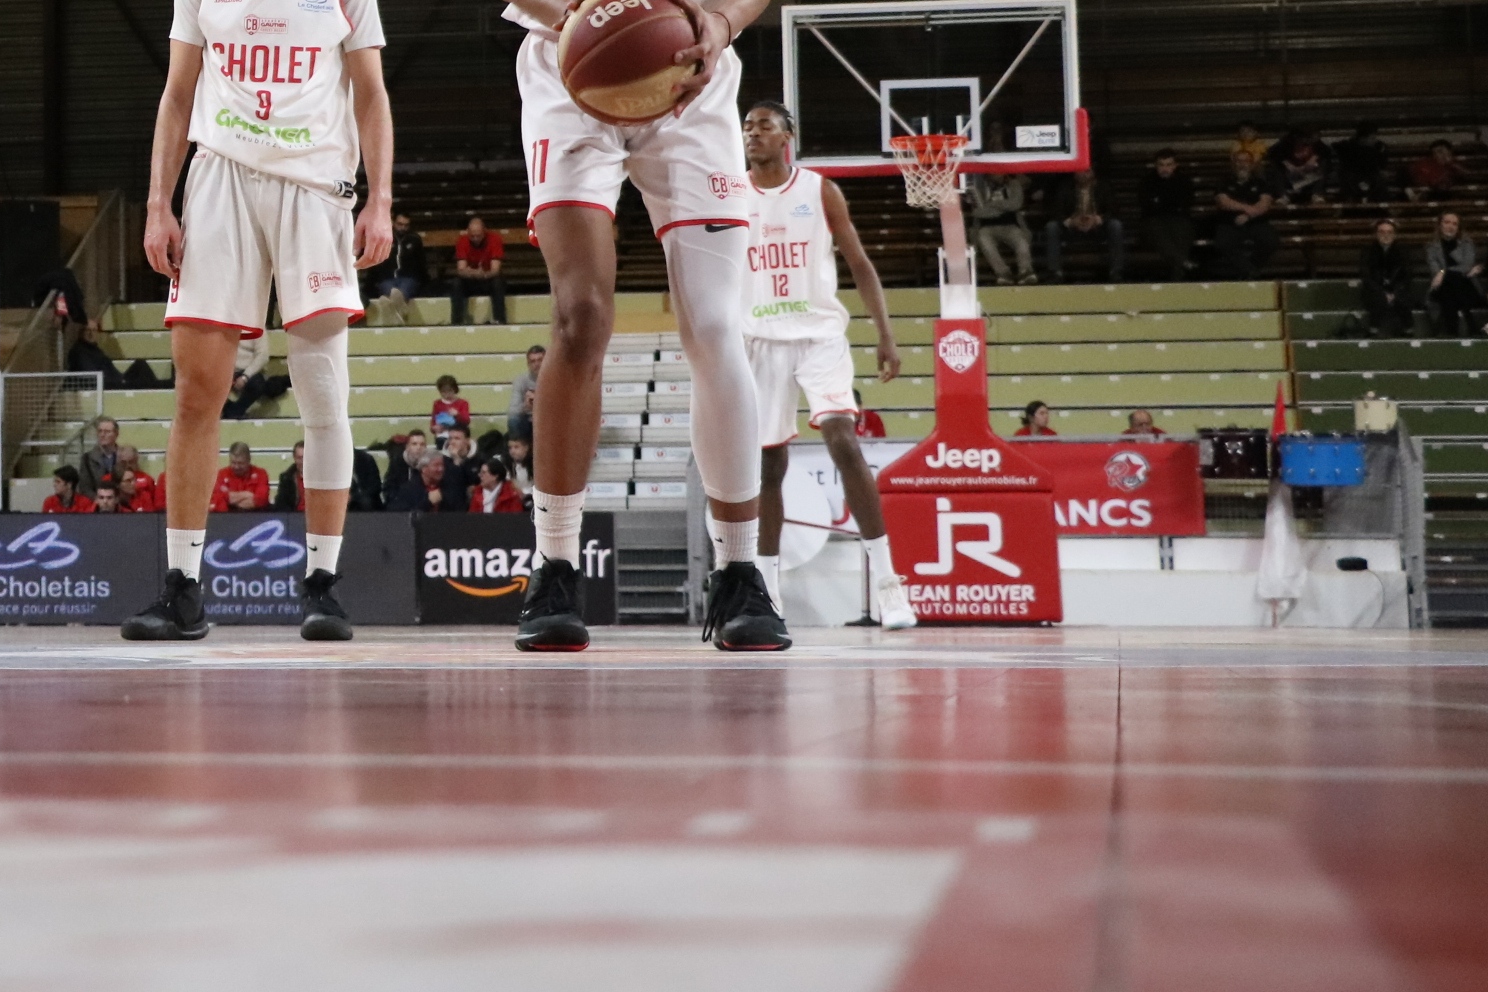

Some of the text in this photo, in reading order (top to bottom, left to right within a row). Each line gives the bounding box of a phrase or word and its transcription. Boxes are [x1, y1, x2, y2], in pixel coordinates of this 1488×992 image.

[212, 42, 322, 85] CHOLET
[255, 90, 272, 121] 9
[532, 139, 550, 187] 11
[747, 241, 810, 273] CHOLET
[771, 273, 789, 297] 12
[938, 340, 981, 360] CHOLET
[926, 442, 1002, 472] Jeep
[889, 475, 1039, 488] www.jeanrouyerautomobiles.fr
[955, 583, 1036, 602] ROUYER
[22, 604, 50, 616] pour
[245, 603, 273, 616] pour
[912, 602, 1028, 615] AUTOMOBILES
